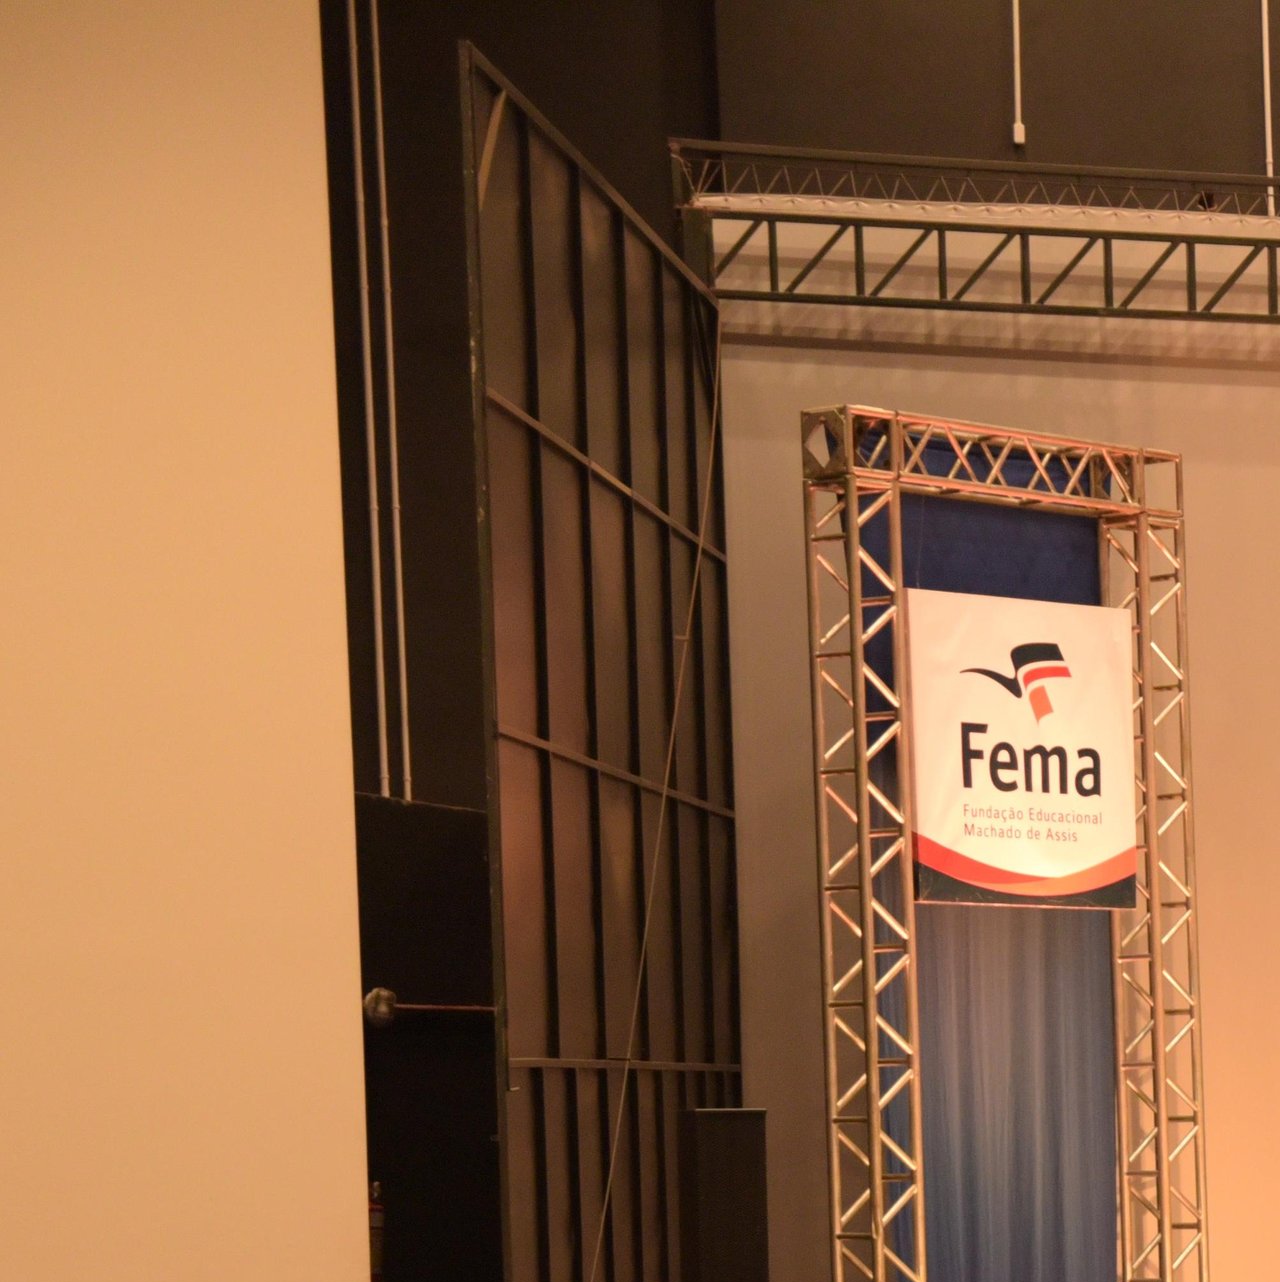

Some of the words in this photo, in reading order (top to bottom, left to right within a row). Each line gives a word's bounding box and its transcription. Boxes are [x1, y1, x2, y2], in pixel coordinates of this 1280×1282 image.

[961, 721, 1102, 797] Fema
[963, 803, 1024, 821] Fundação
[1028, 807, 1103, 825] Educacional
[964, 823, 1022, 839] Machado
[1026, 825, 1041, 840] de
[1045, 827, 1078, 842] Assis
